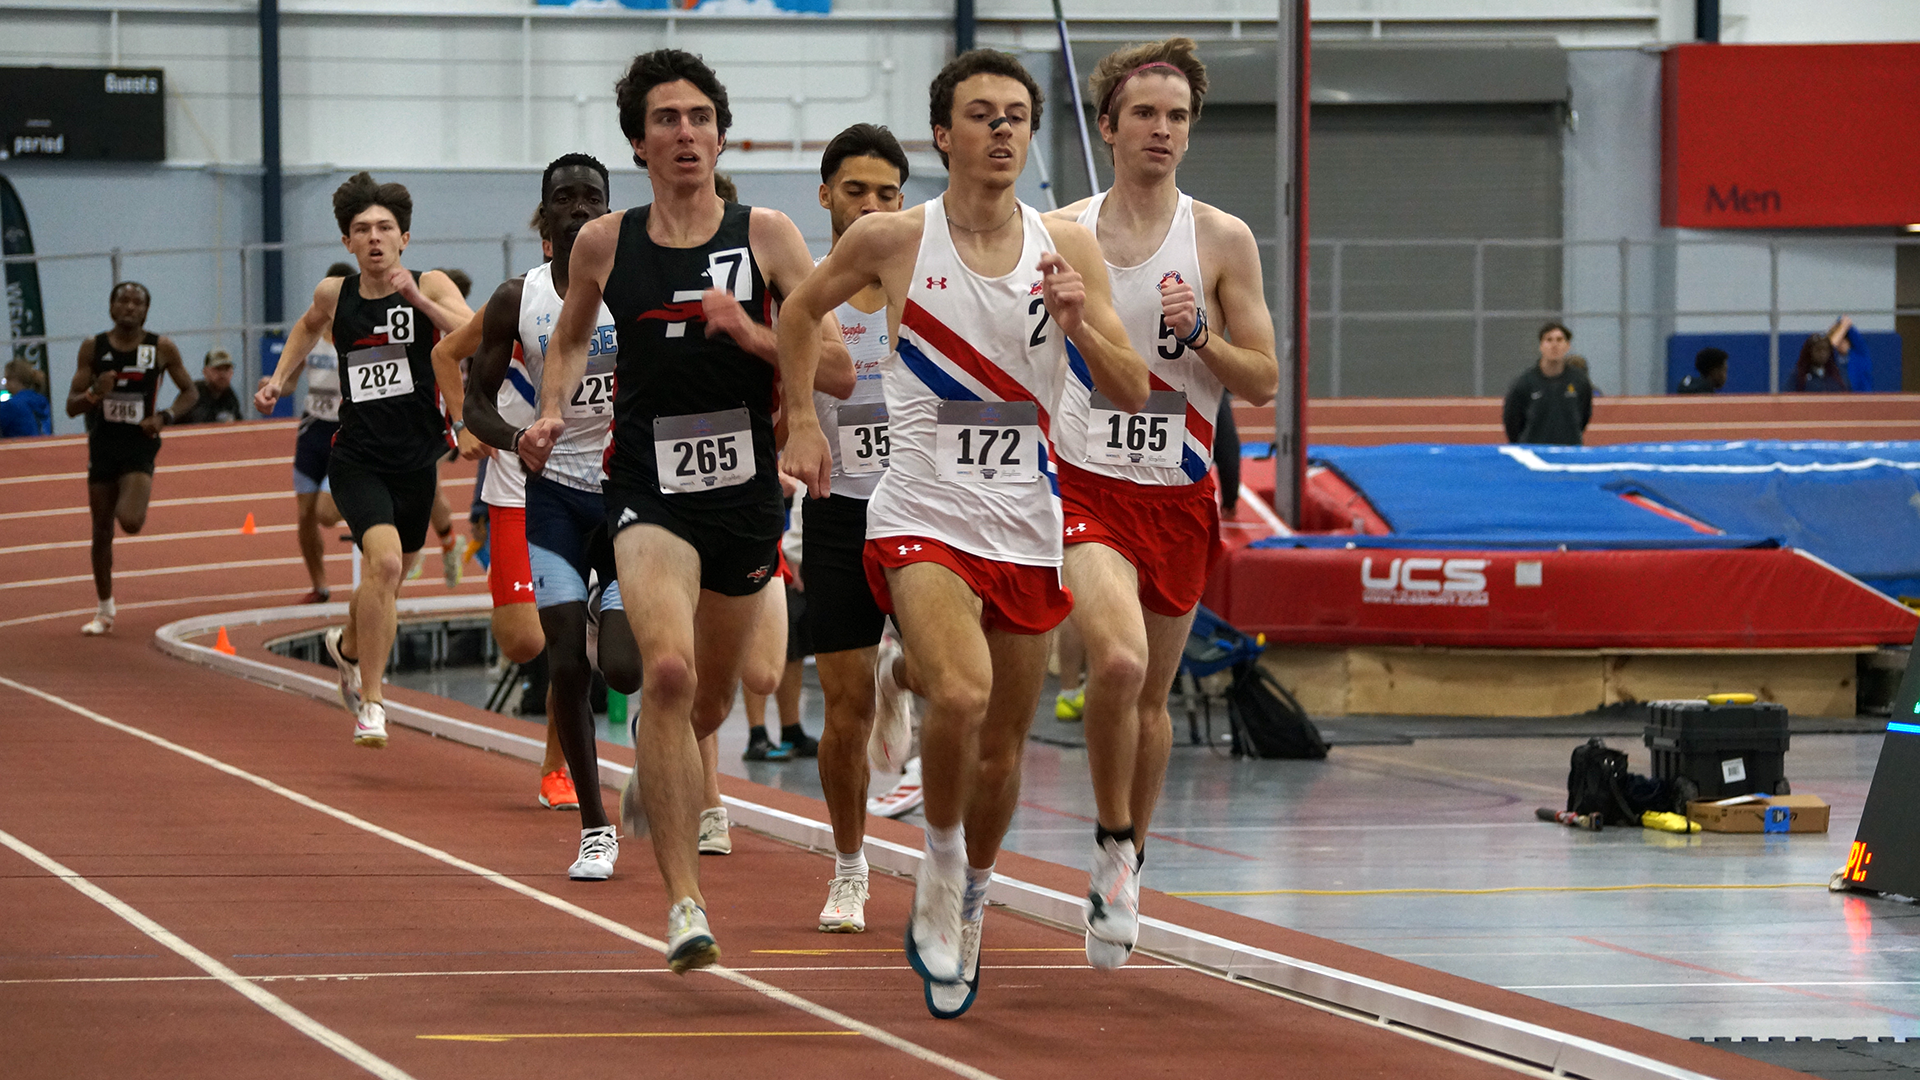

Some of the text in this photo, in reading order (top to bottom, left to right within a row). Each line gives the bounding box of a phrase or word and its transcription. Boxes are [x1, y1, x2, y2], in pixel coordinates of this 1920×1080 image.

[105, 72, 158, 94] Guests
[14, 133, 64, 156] period
[1705, 184, 1781, 214] Men
[714, 253, 743, 298] 7
[391, 311, 410, 341] 8
[1028, 298, 1050, 347] 2
[1157, 313, 1185, 360] 5
[358, 362, 401, 390] 282
[854, 426, 890, 458] 35
[957, 428, 1020, 465] 172
[1107, 414, 1168, 451] 165
[673, 436, 737, 477] 265
[1361, 557, 1487, 592] UCS
[1843, 841, 1872, 882] PL:
